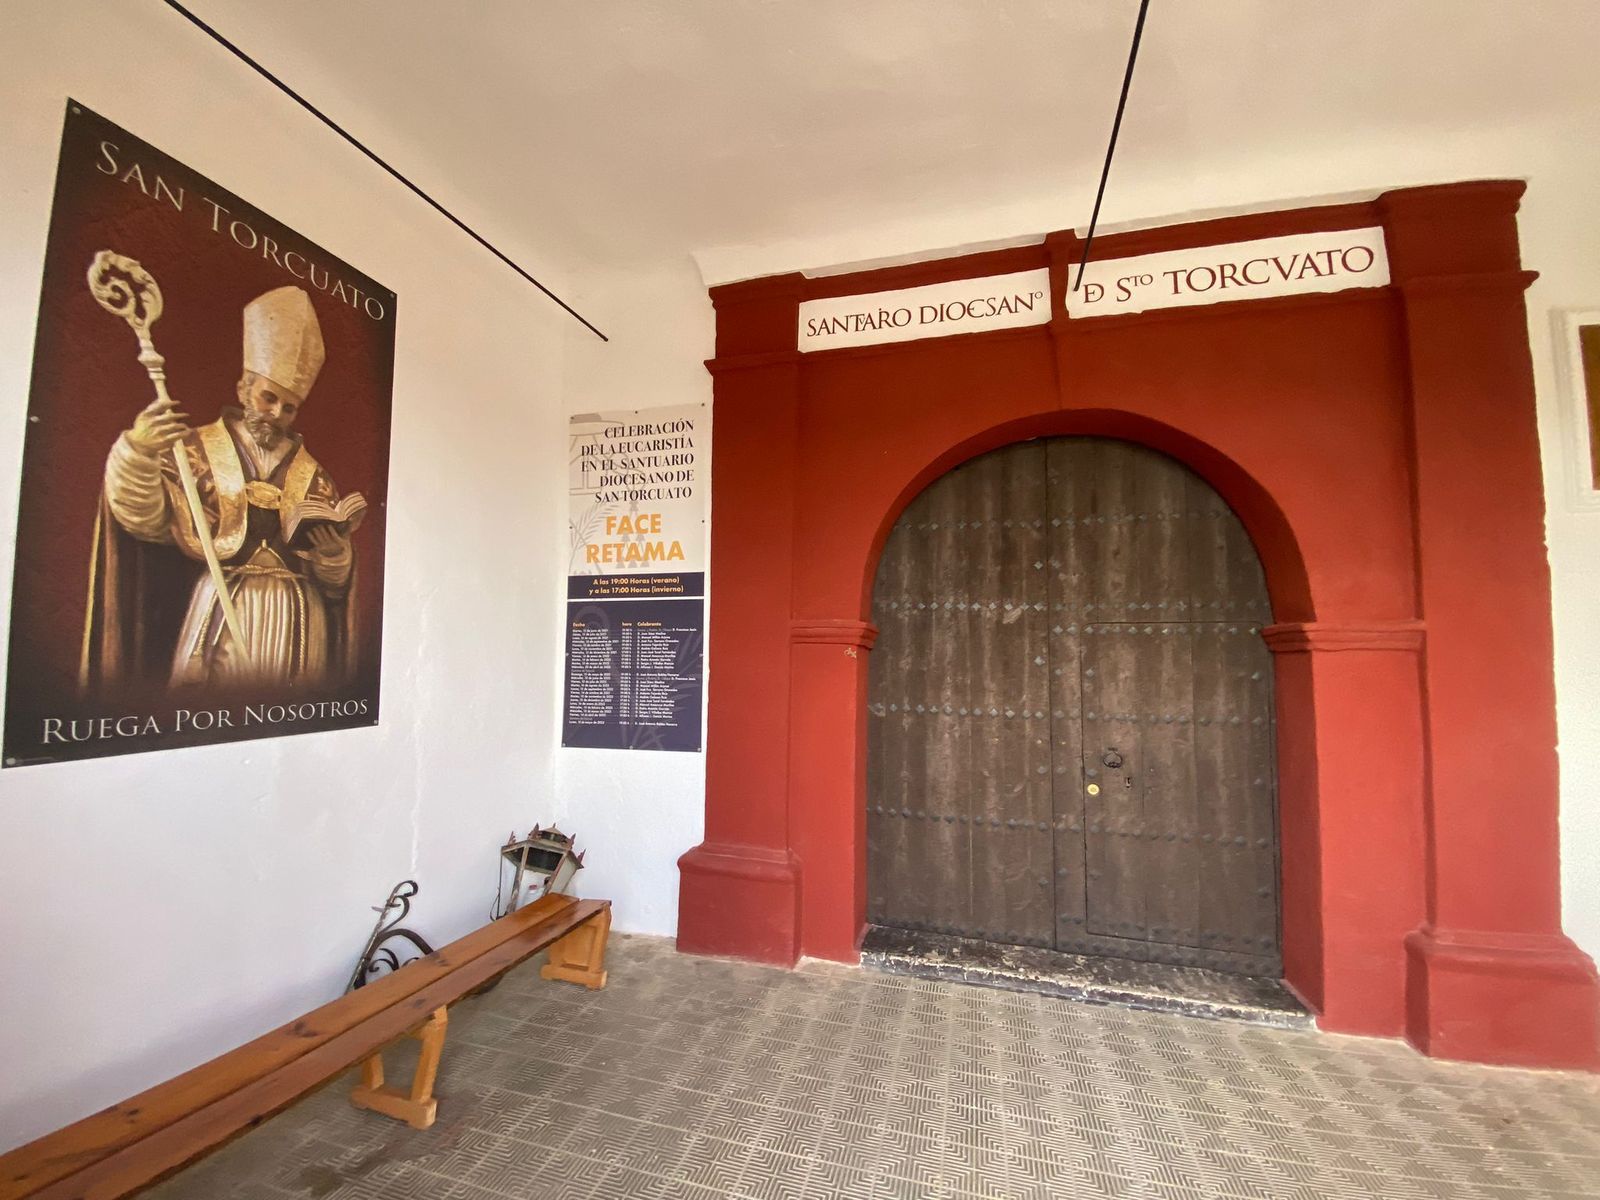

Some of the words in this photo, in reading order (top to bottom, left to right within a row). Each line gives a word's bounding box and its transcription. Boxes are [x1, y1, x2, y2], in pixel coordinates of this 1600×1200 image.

[96, 139, 185, 212] SAN
[202, 195, 386, 323] TORCUATO
[1163, 246, 1374, 295] TORCVATO
[604, 418, 694, 439] CELEBRACIÓN
[581, 445, 599, 456] DE
[600, 443, 615, 455] LA
[618, 434, 693, 454] EUCARISTÍA
[581, 460, 597, 472] EN
[602, 459, 618, 471] EL
[621, 453, 694, 469] SANTUARIO
[600, 472, 674, 487] DIOCESANO
[676, 470, 694, 482] DE
[606, 514, 661, 535] FACE
[586, 541, 685, 563] RETAMA
[651, 576, 679, 584] (verano)
[651, 585, 683, 593] (invierno)
[40, 712, 162, 745] RUEGA
[173, 706, 233, 732] POR
[243, 697, 370, 726] NOSOTROS
